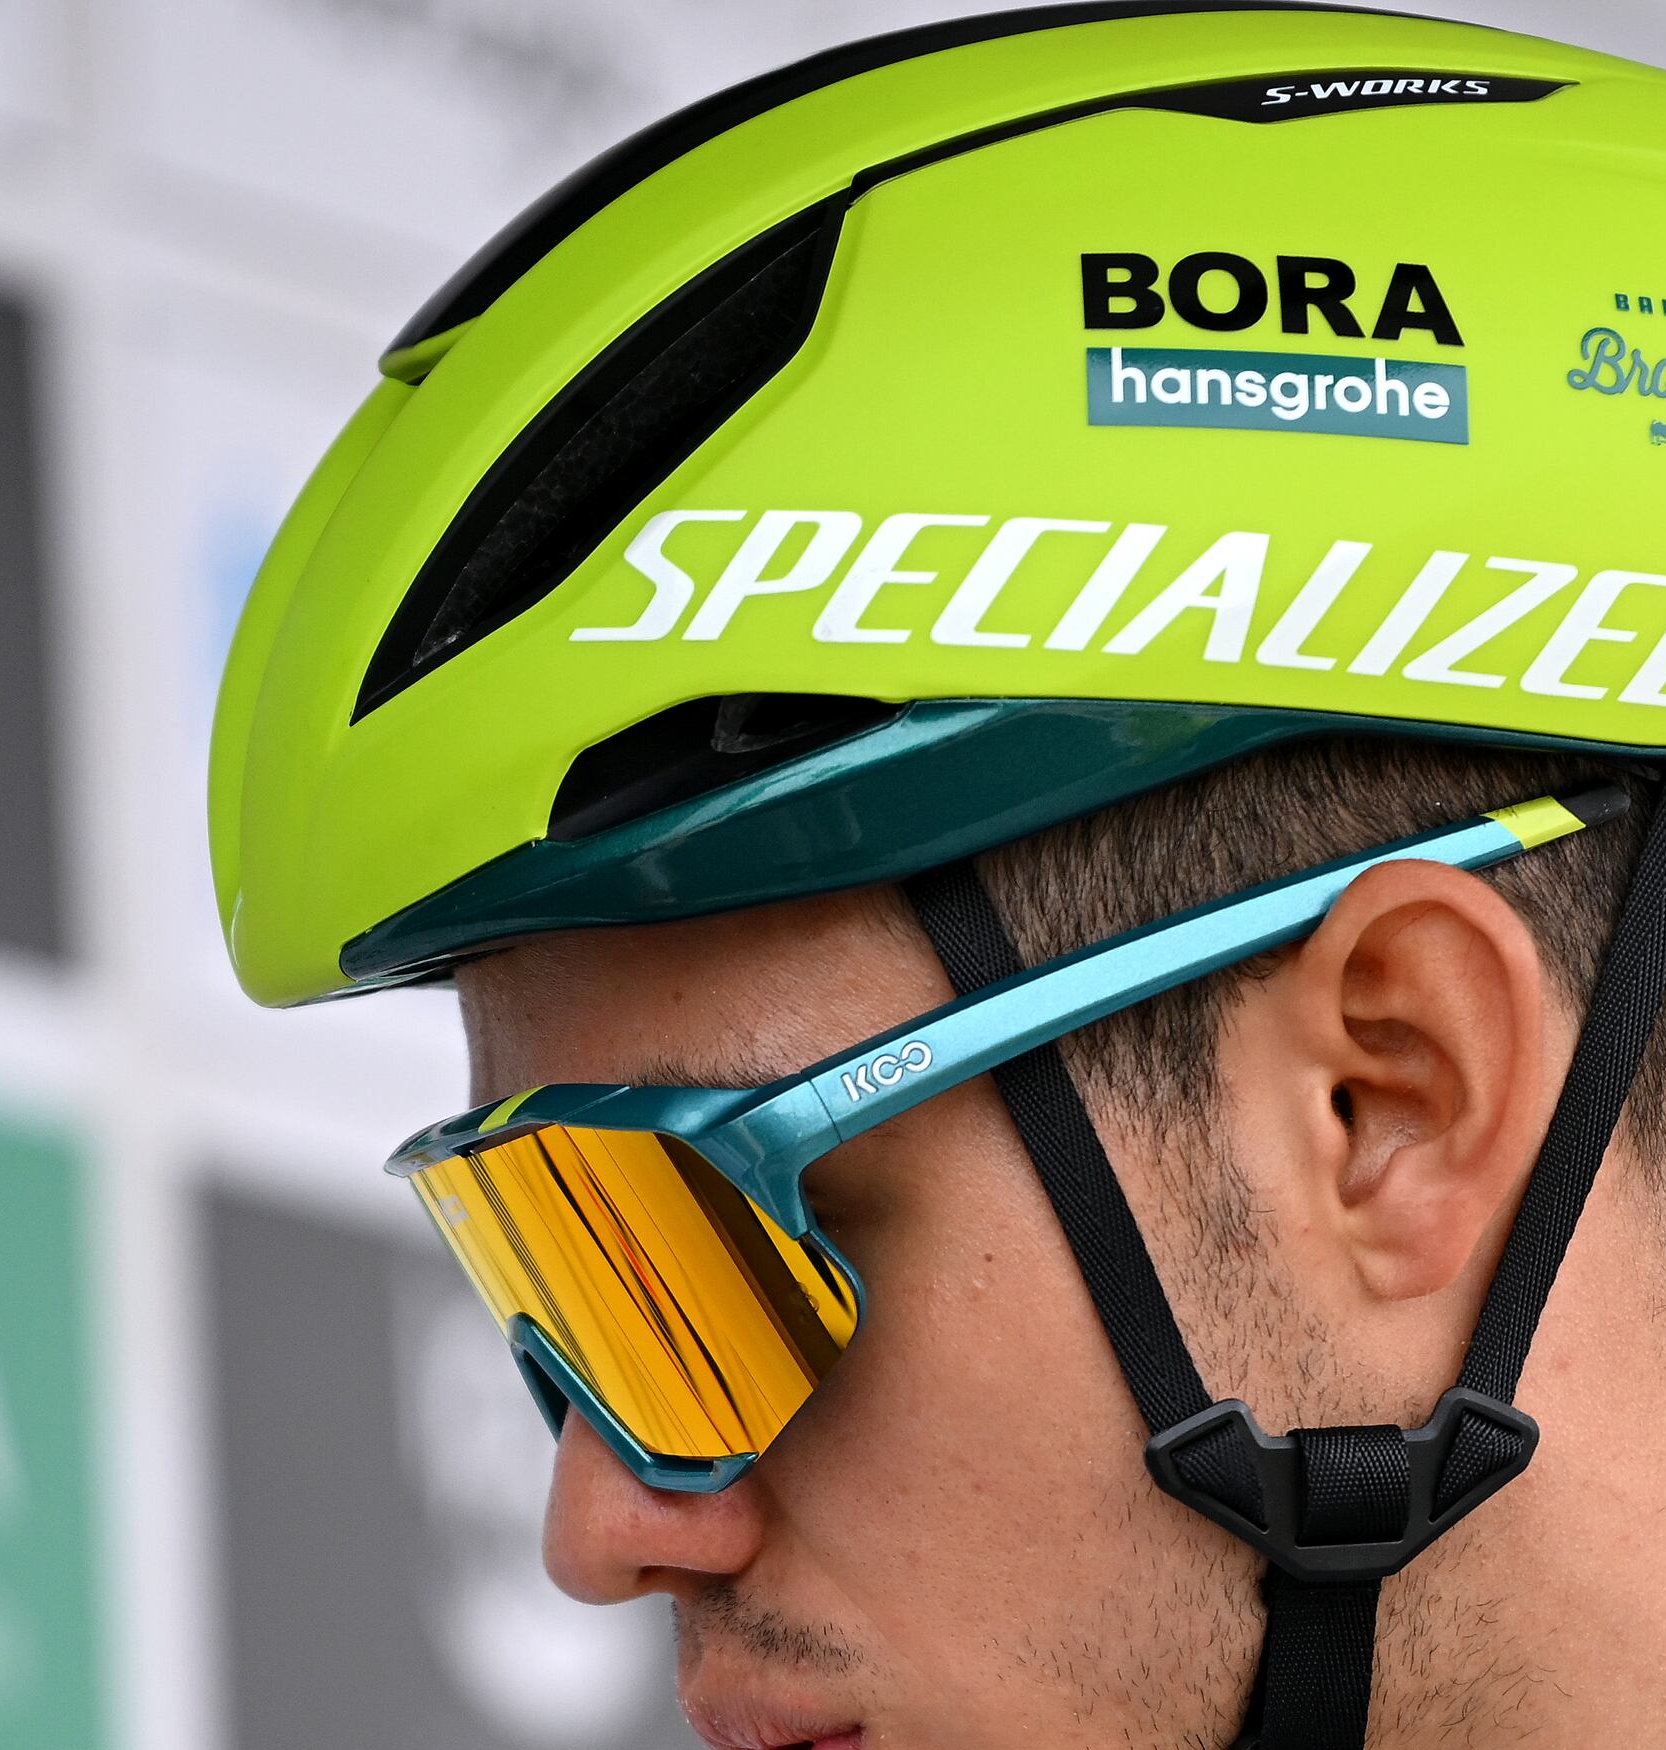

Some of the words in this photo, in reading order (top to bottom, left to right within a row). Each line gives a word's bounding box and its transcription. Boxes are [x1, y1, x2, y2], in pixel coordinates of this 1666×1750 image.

[1261, 79, 1491, 106] S-WORKS
[1080, 251, 1465, 347] BORA
[1110, 347, 1451, 421] hansgrohe
